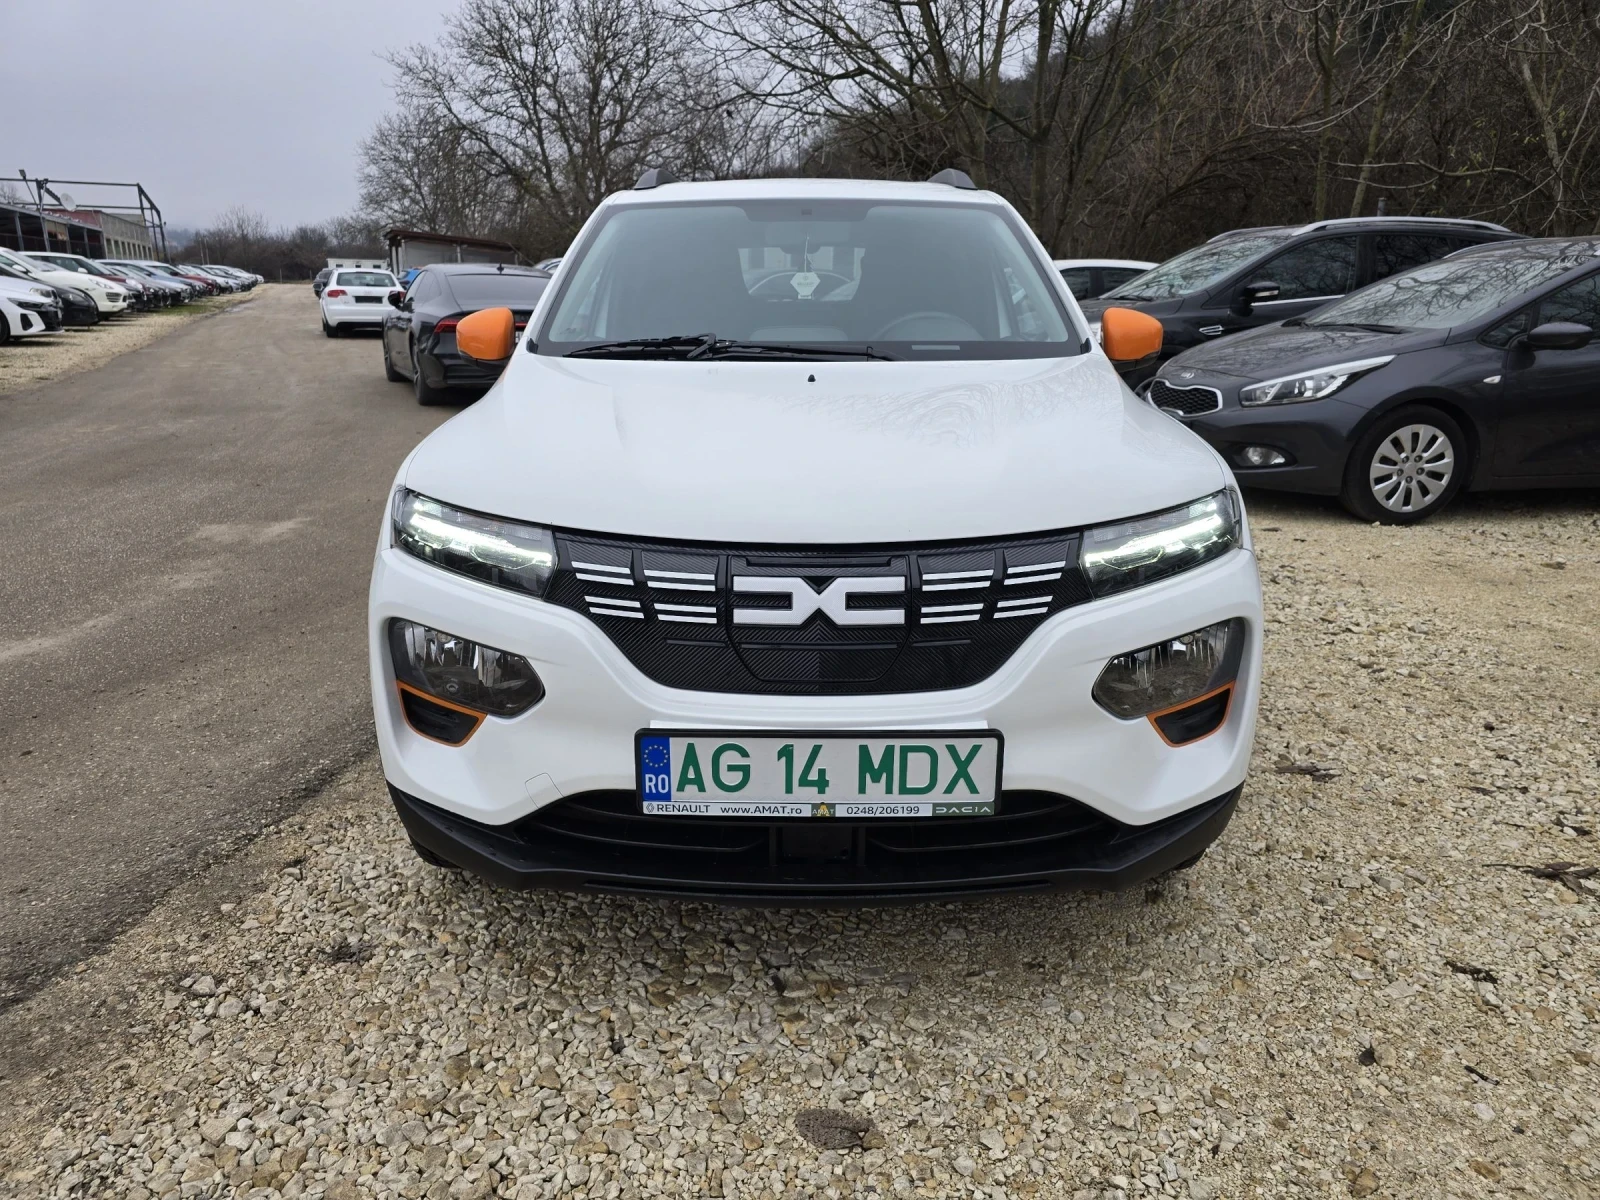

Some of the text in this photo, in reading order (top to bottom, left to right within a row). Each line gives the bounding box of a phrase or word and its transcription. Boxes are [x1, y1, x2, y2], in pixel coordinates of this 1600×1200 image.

[676, 742, 983, 795] AG 14 MDX
[645, 773, 669, 794] RO
[656, 803, 711, 814] RENAULT
[720, 804, 803, 815] www.AMAT.ro
[846, 805, 920, 816] 0248/206199
